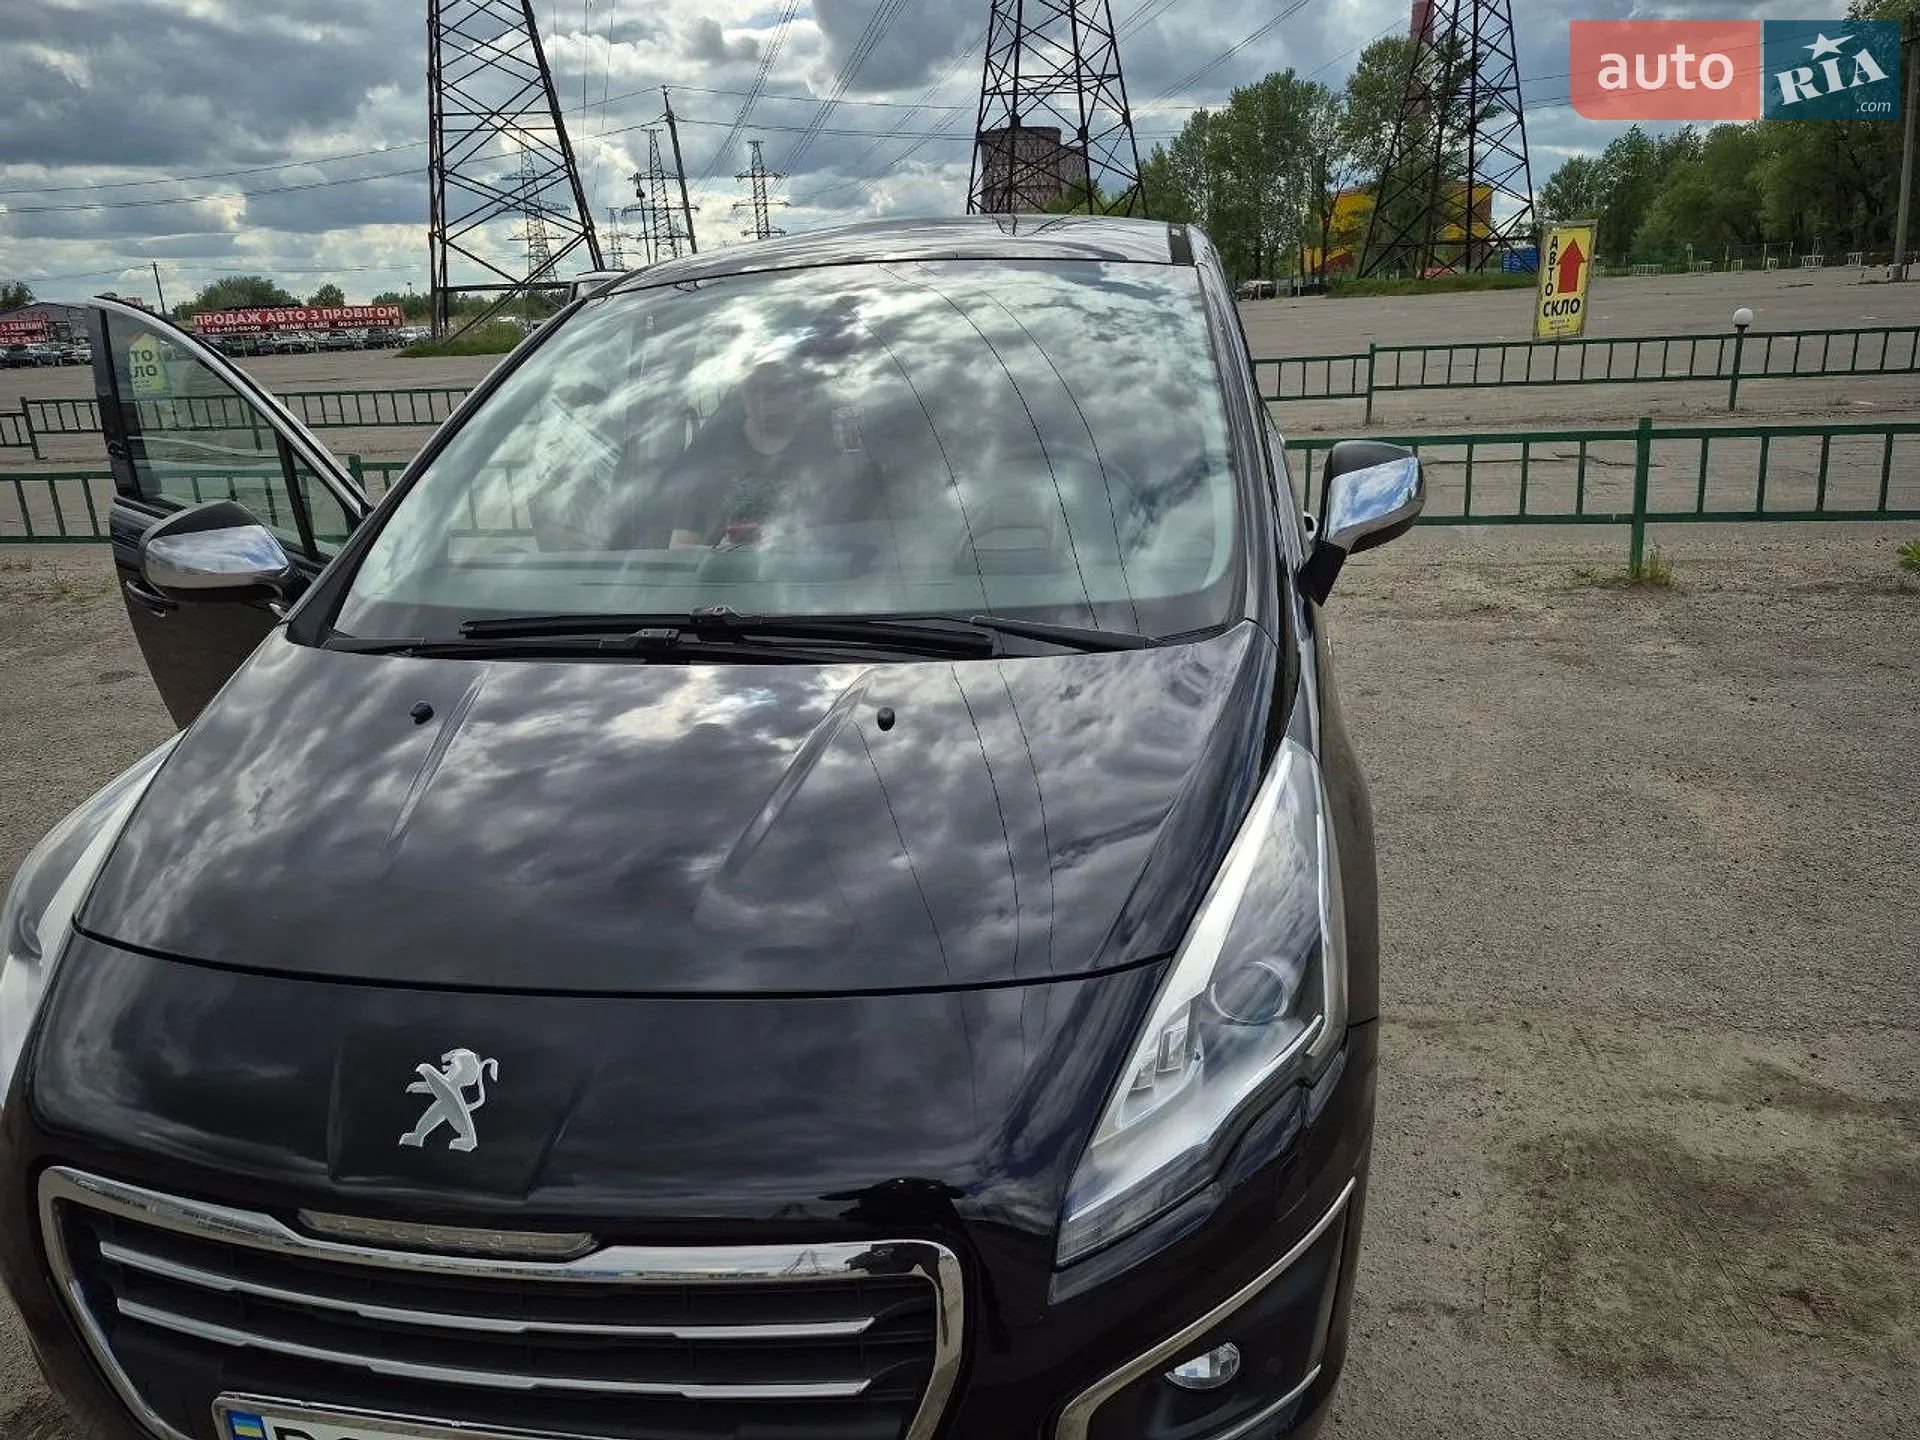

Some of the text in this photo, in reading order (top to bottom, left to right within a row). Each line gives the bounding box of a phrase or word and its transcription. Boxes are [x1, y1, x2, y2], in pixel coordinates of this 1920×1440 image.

[1545, 235, 1559, 297] АВТО
[193, 313, 261, 326] ПРОДАЖ
[266, 310, 307, 322] АВТО
[322, 306, 400, 320] ПРОБІГОМ
[1543, 298, 1581, 317] СКЛО
